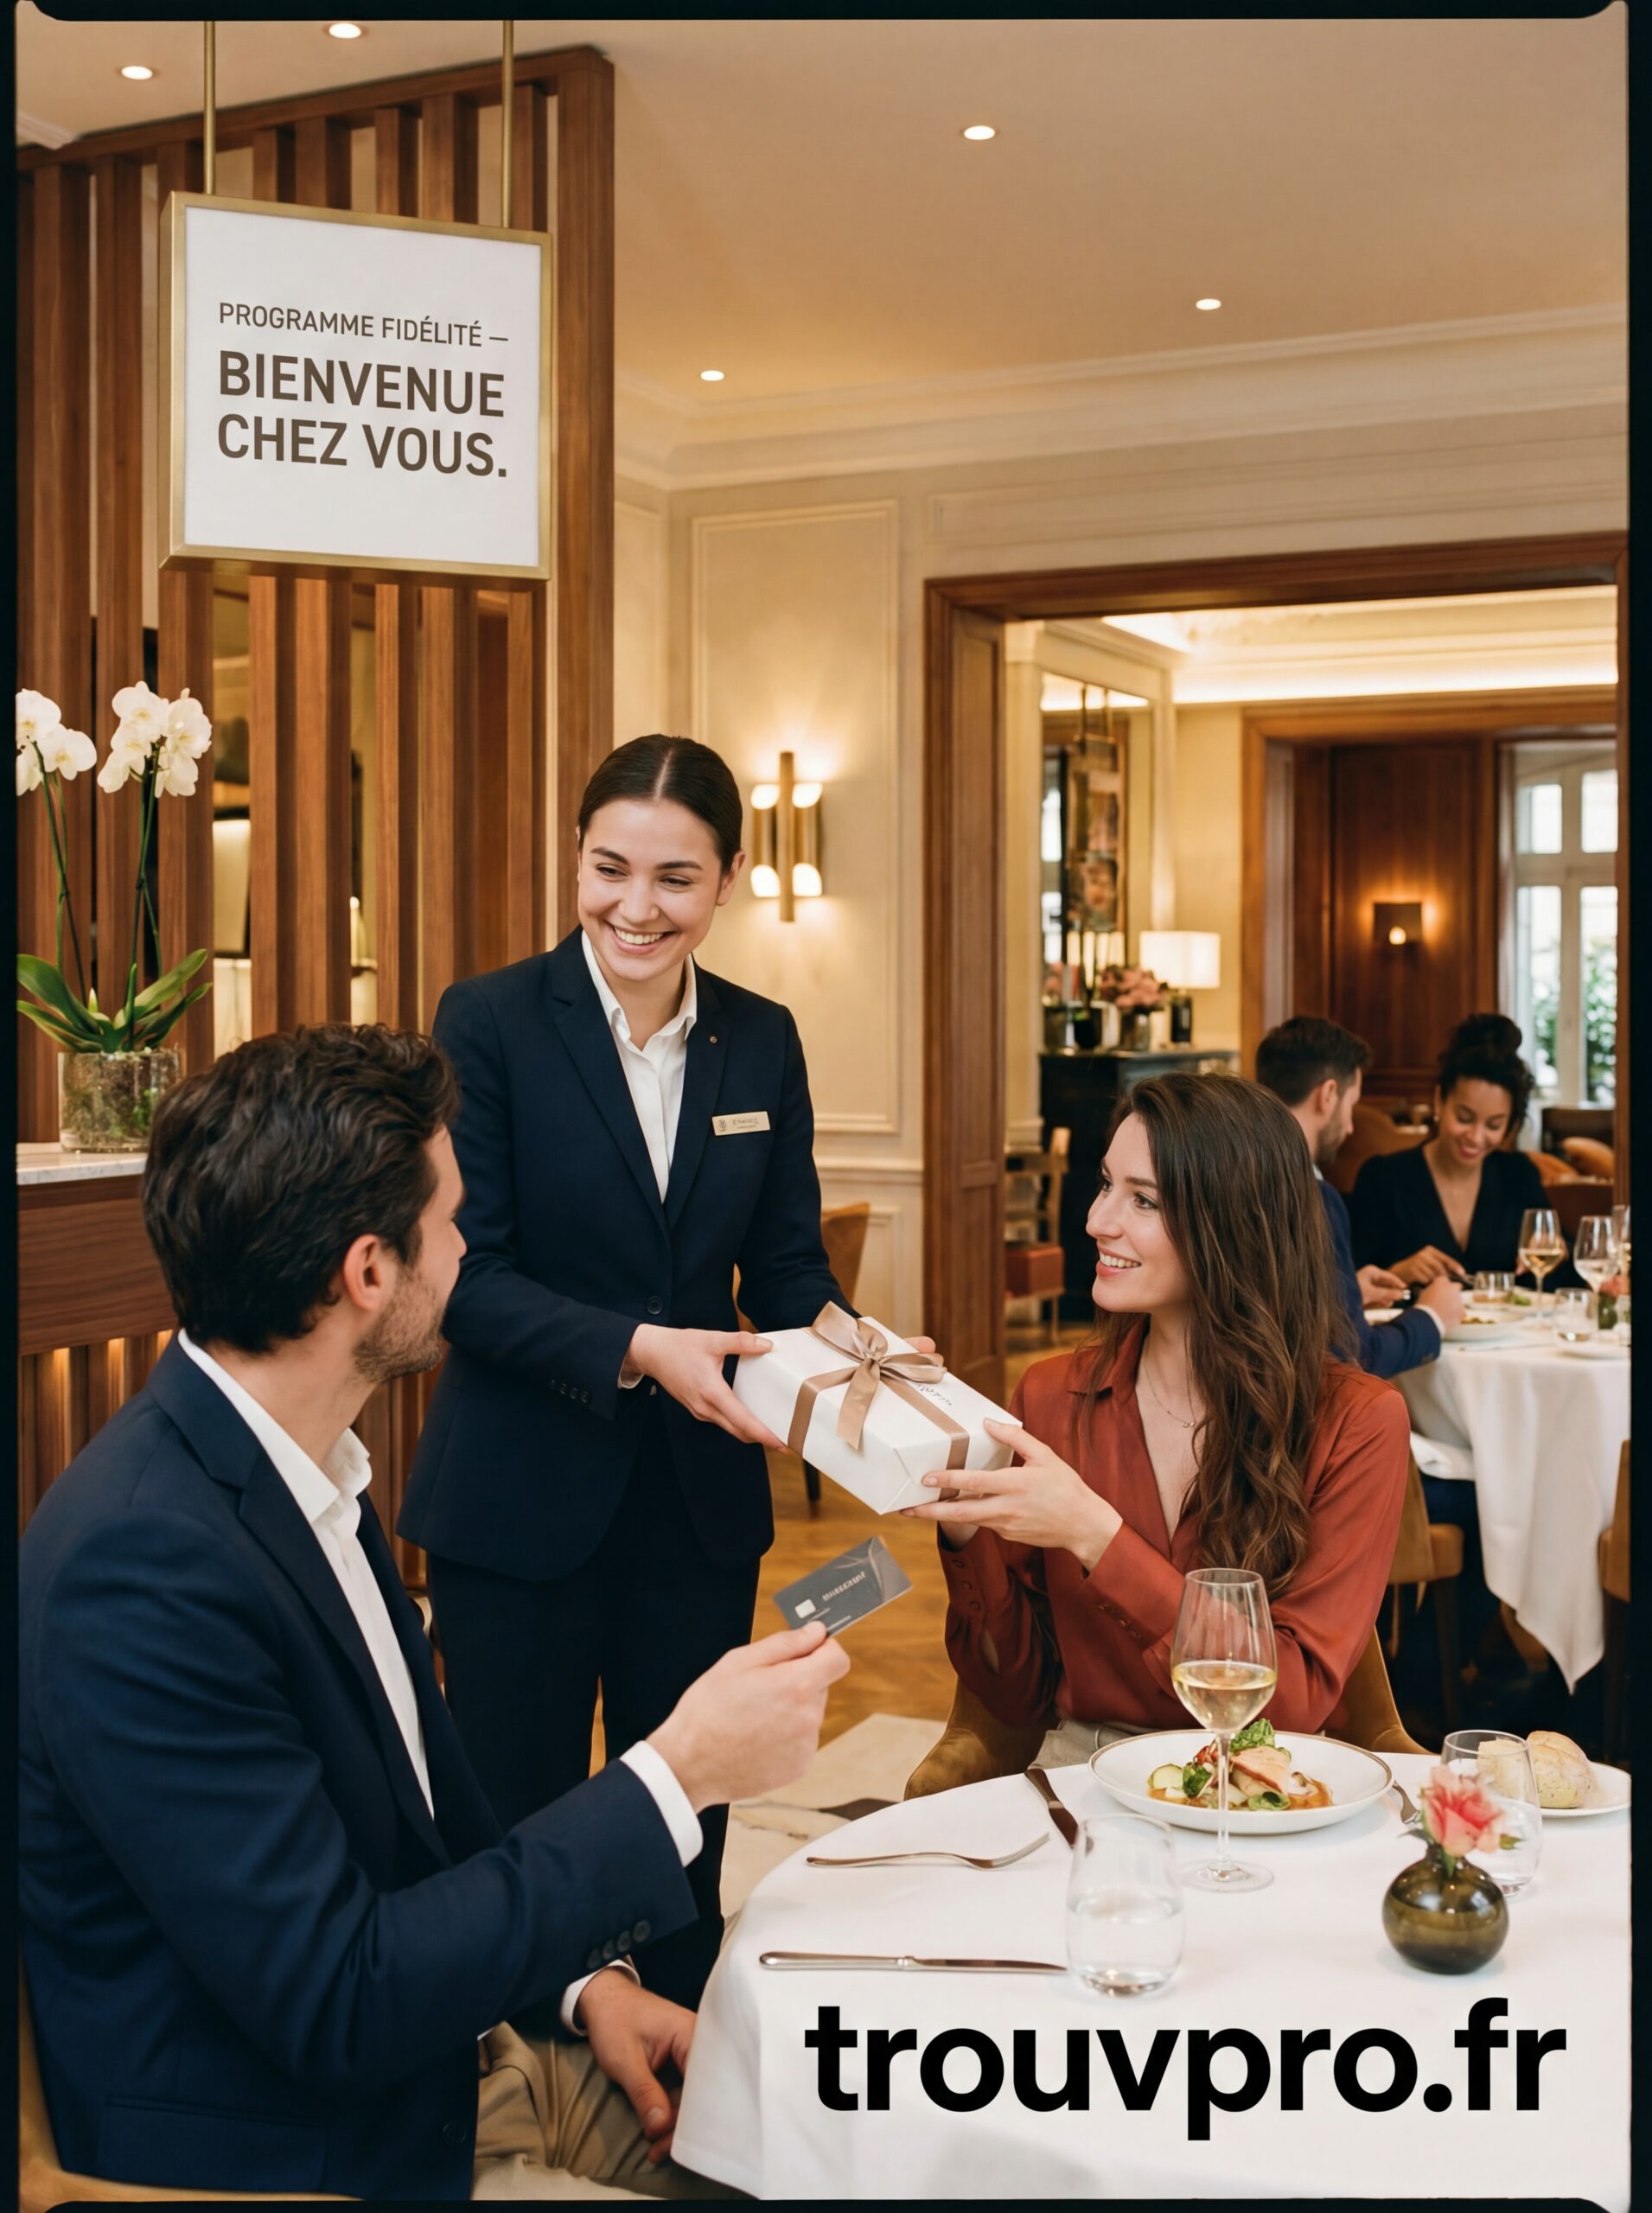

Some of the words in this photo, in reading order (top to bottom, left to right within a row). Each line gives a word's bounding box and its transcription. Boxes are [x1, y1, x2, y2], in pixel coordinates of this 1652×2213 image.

[220, 302, 374, 337] PROGRAMME
[382, 316, 482, 348] FIDÉLITÉ
[220, 350, 505, 418] BIENVENUE
[218, 413, 348, 467] CHEZ
[361, 424, 507, 478] VOUS.
